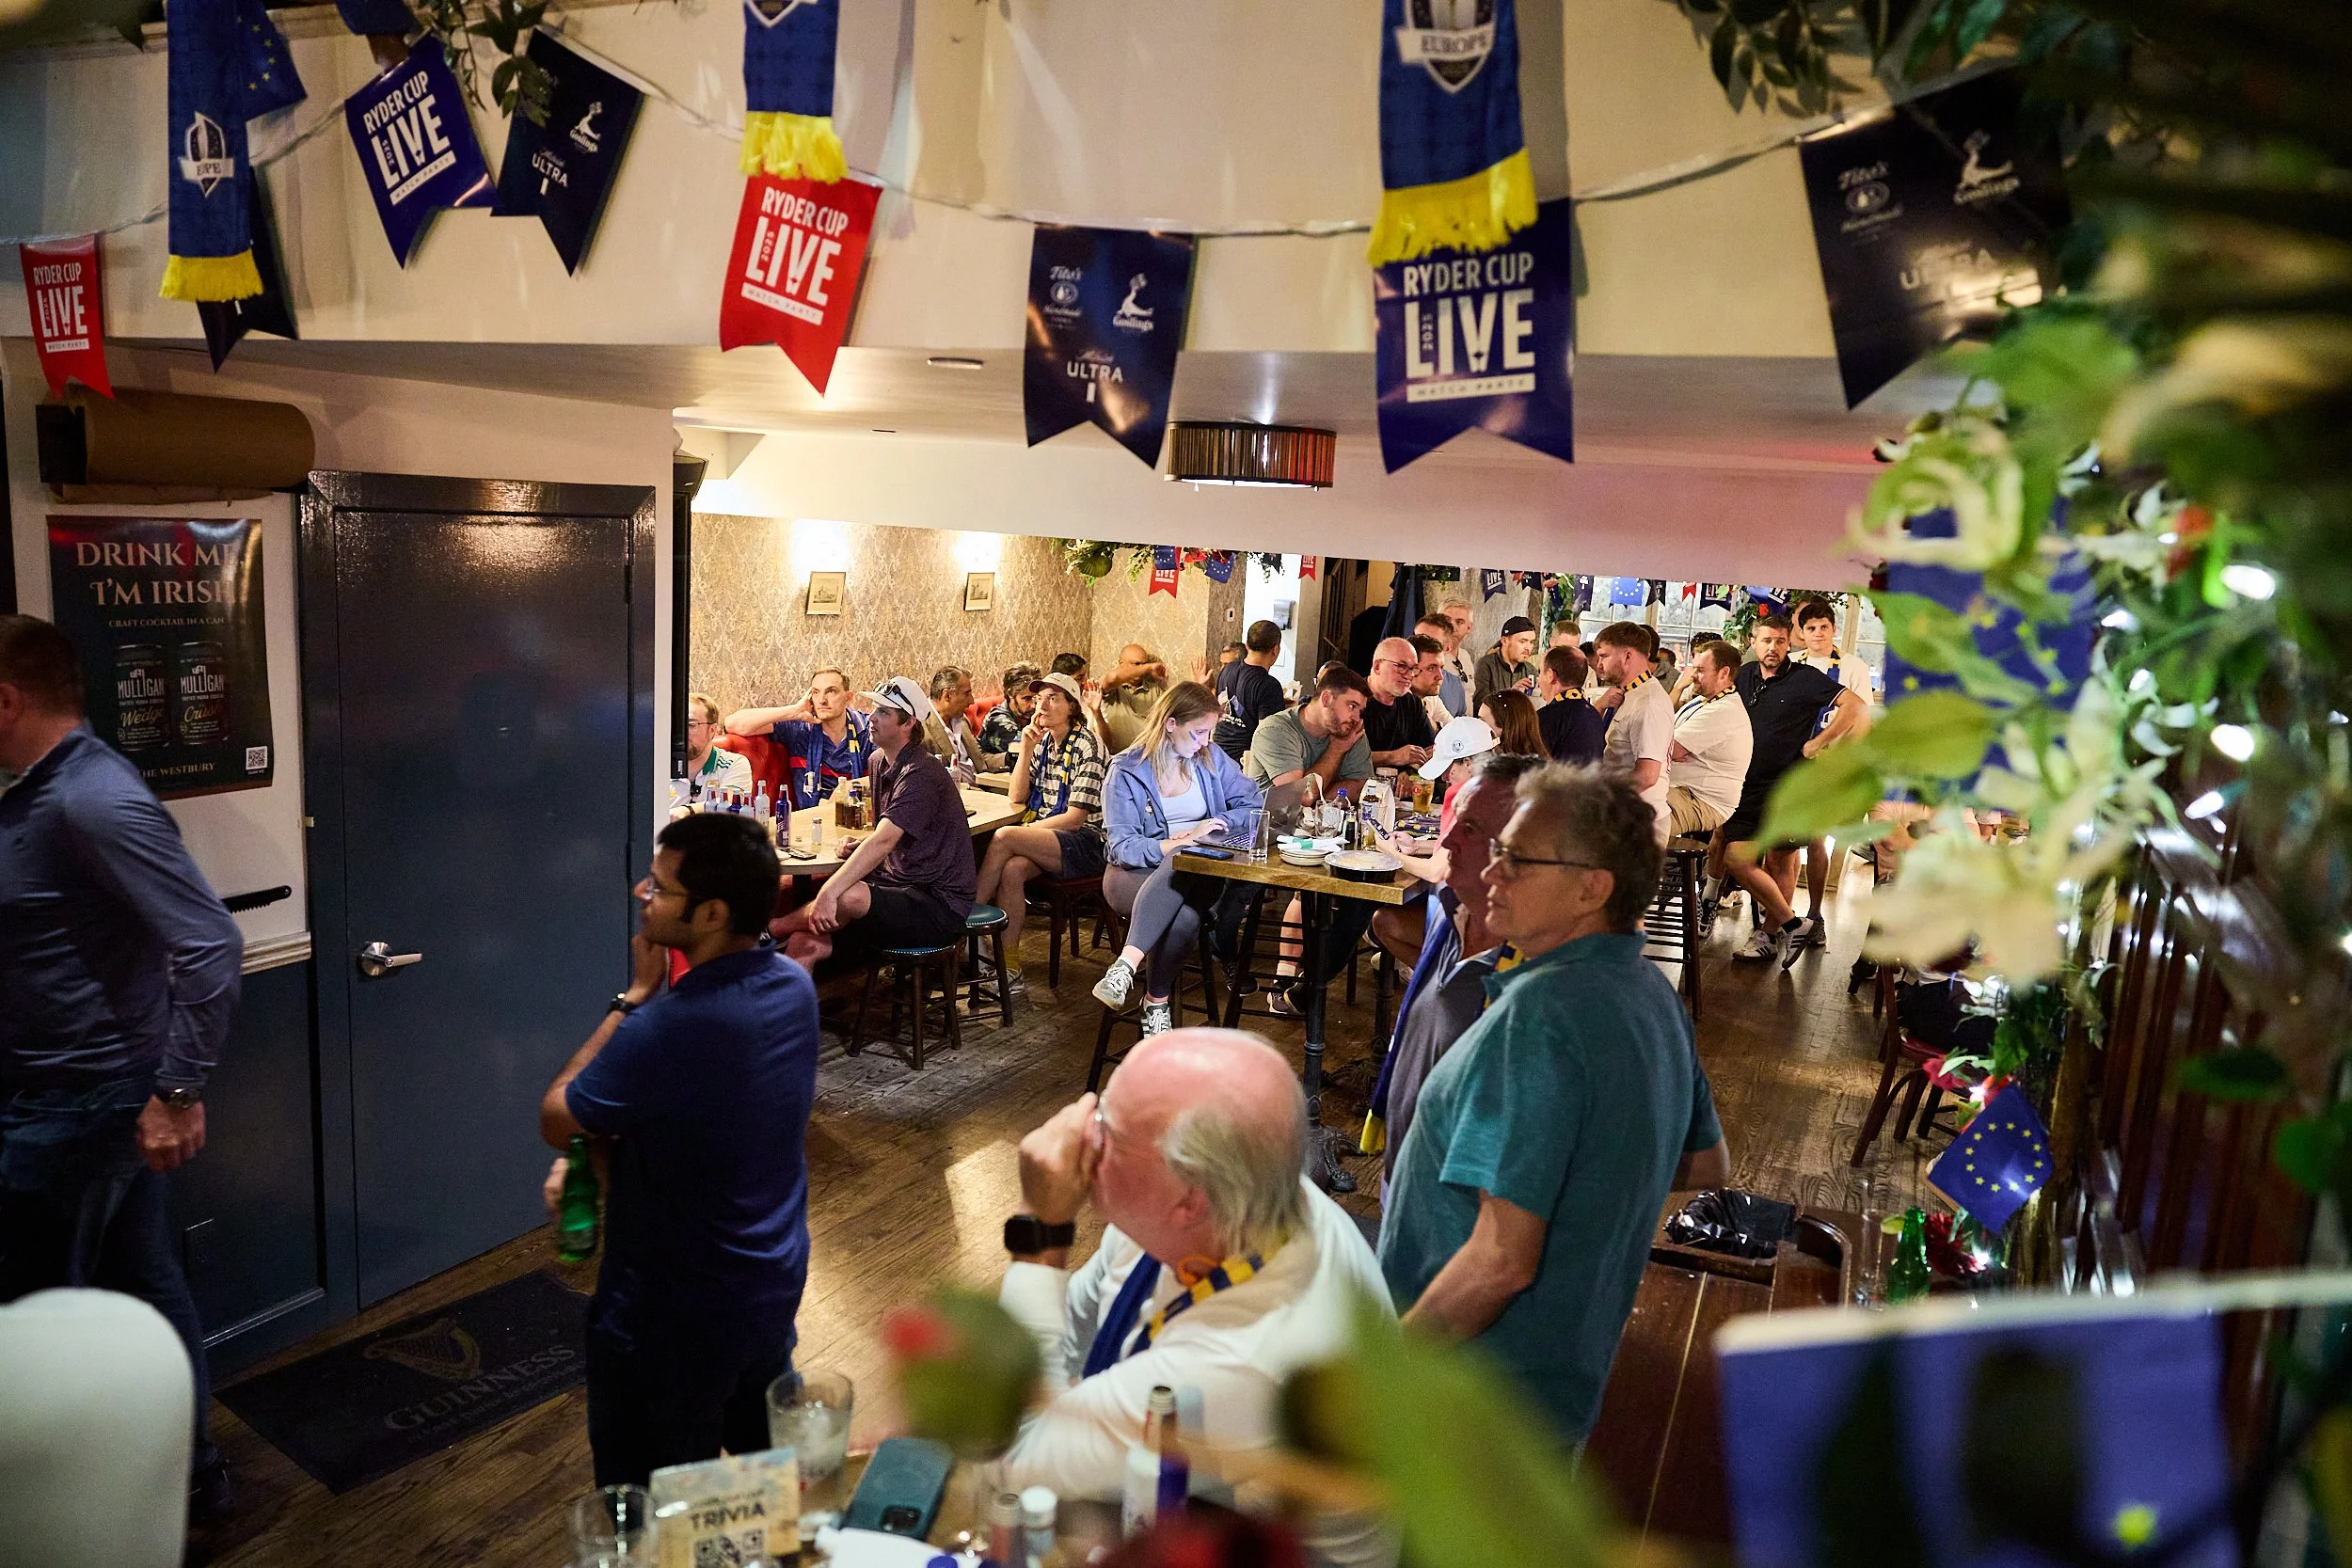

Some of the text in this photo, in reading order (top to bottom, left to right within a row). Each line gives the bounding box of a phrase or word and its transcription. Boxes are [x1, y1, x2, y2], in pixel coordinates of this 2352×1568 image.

[363, 71, 428, 135] RYDER CUP
[371, 94, 451, 190] LIVE
[532, 151, 569, 187] ULTRA
[761, 186, 849, 238] RYDER CUP
[745, 215, 843, 307] LIVE
[760, 230, 775, 262] 2025
[33, 262, 82, 286] RYDER CUP
[1403, 251, 1534, 297] RYDER CUP
[37, 286, 87, 338] LIVE
[1405, 288, 1535, 379] LIVE
[1067, 360, 1123, 384] ULTRA
[76, 541, 188, 566] DRINK
[151, 580, 234, 605] IRISH
[1486, 571, 1503, 586] LIVE
[108, 617, 138, 628] CRAFT
[140, 616, 184, 627] COCKTAIL
[206, 616, 224, 626] CAN
[118, 673, 165, 699] MULLIGAN
[180, 669, 225, 695] MULLIGAN
[160, 763, 215, 776] WESTBURY
[383, 1344, 576, 1430] GUINNESS
[690, 1501, 765, 1532] TRIVIA
